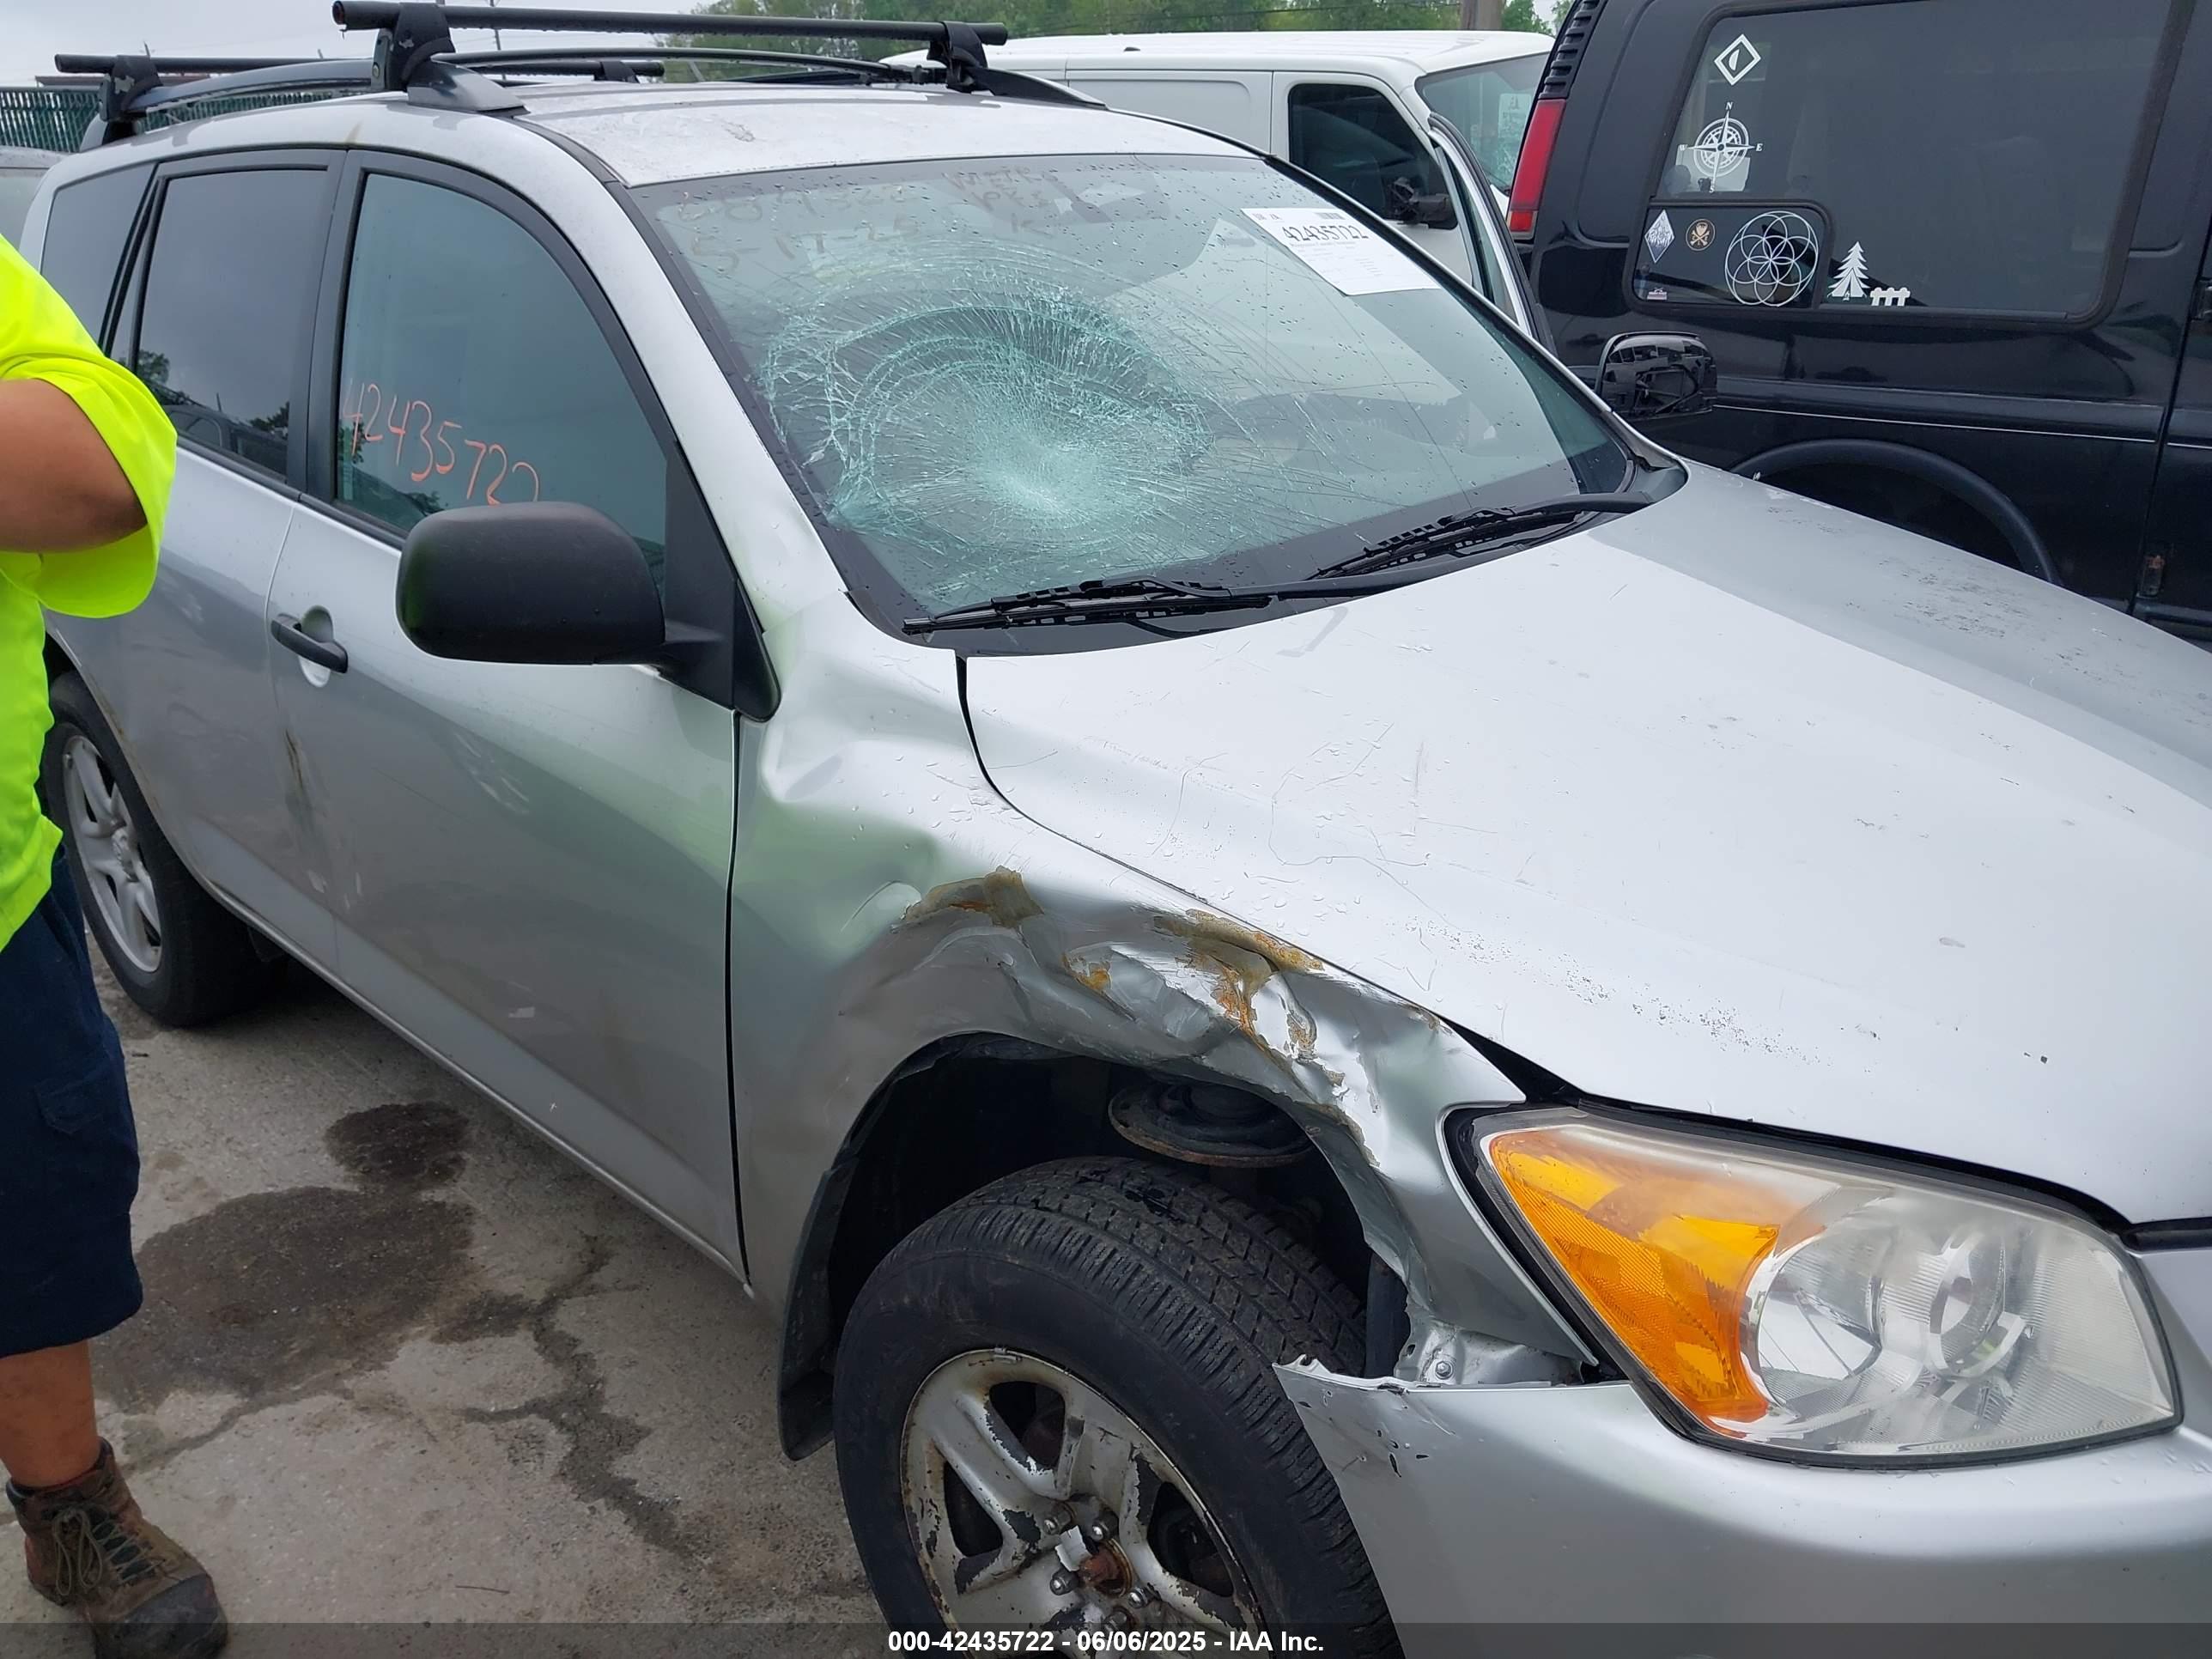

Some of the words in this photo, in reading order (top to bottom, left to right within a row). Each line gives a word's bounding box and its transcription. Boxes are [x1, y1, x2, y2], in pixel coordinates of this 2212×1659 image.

[1725, 101, 1734, 111] N
[1755, 143, 1764, 152] E
[1282, 224, 1370, 242] 42435722
